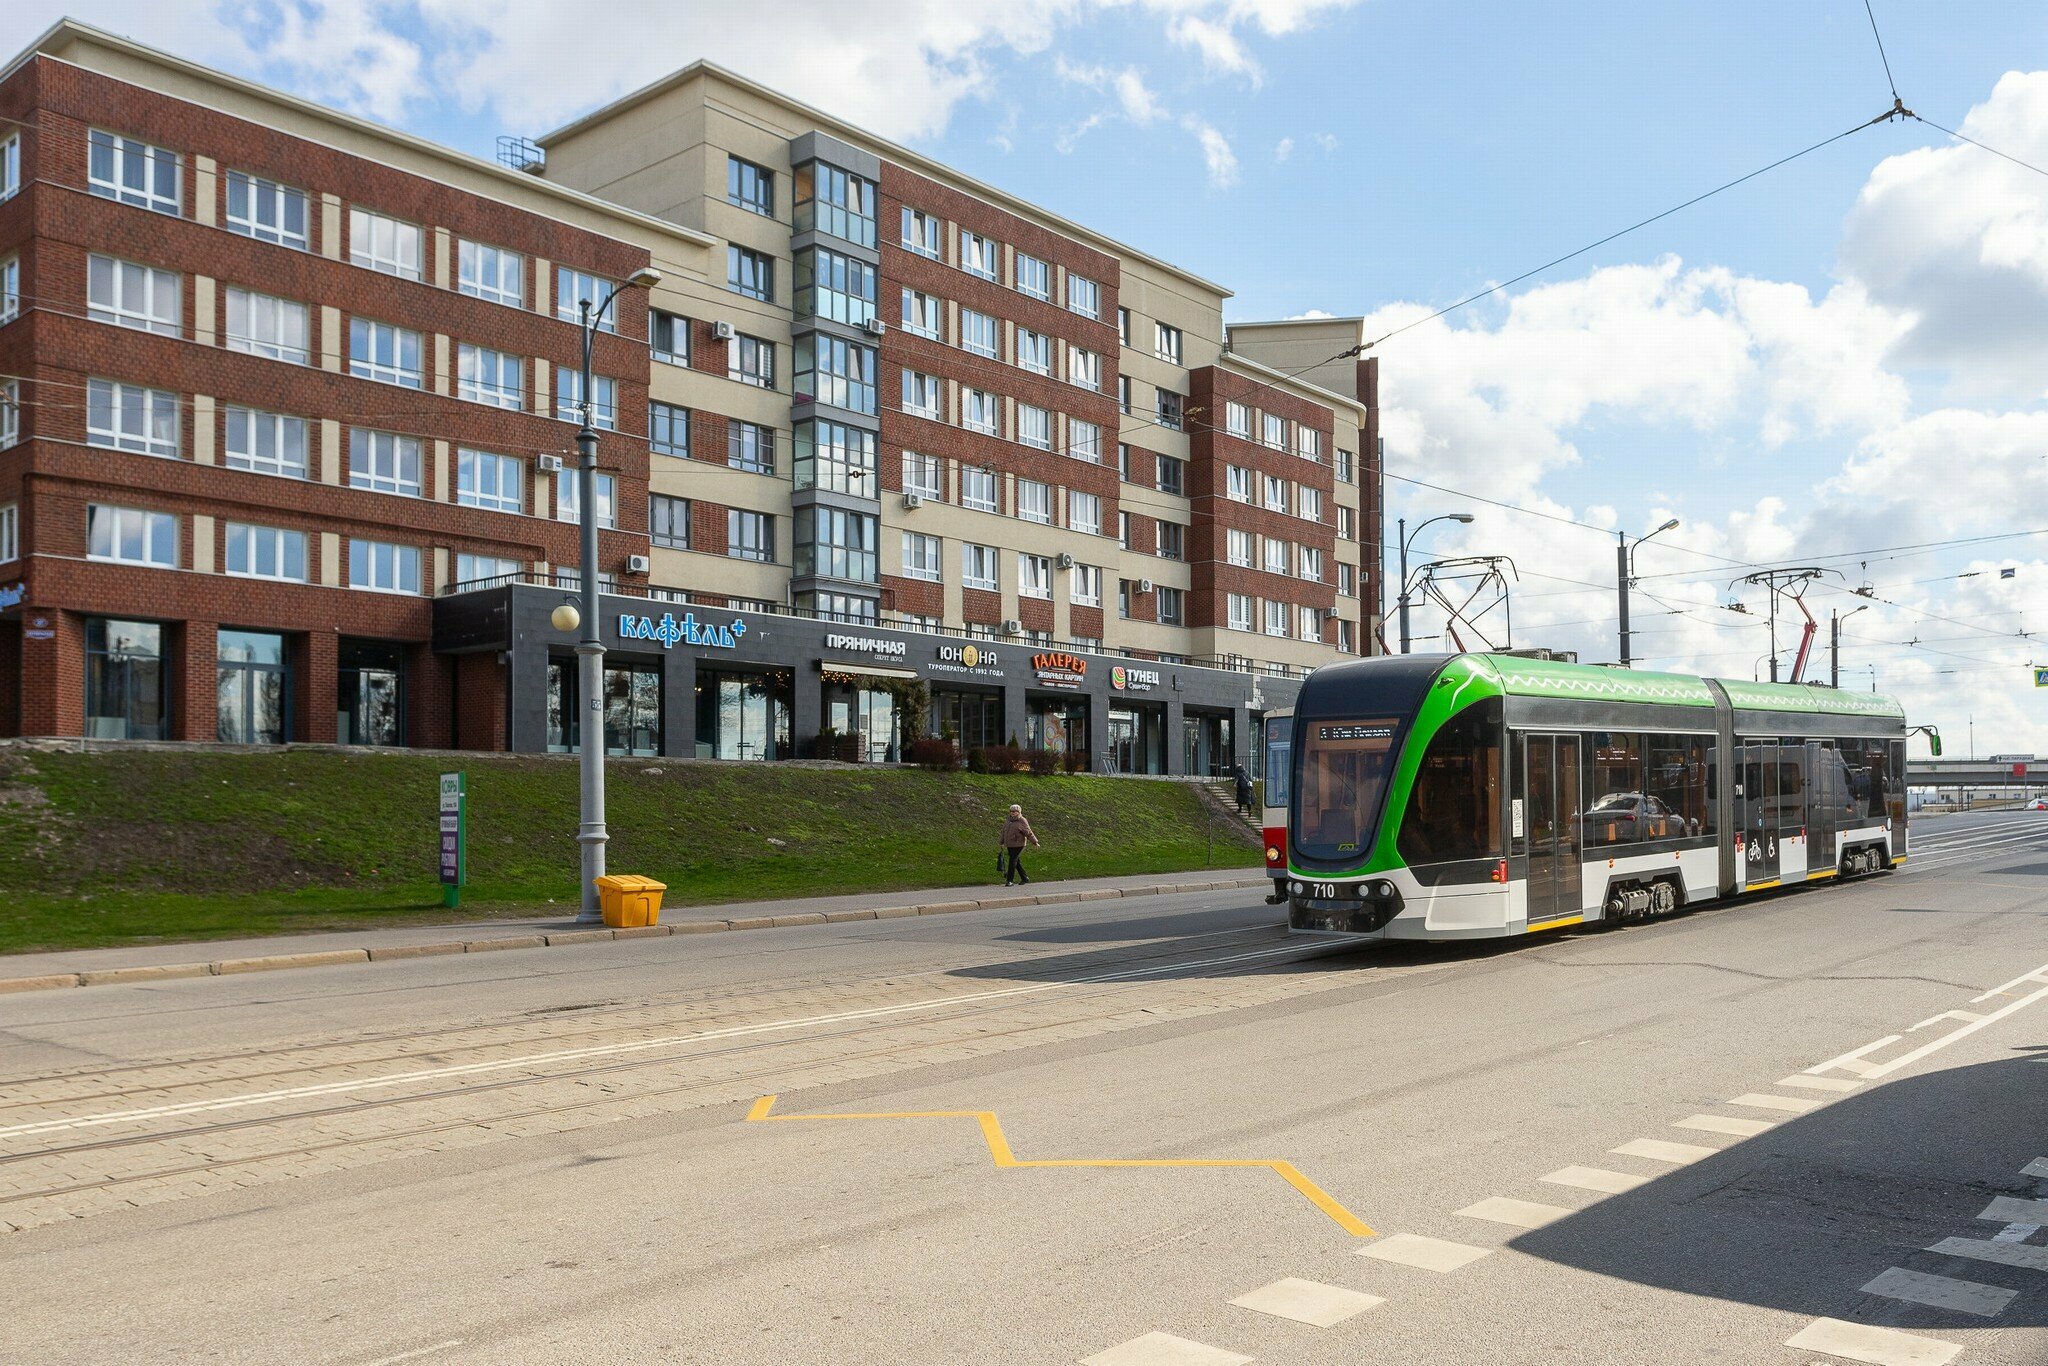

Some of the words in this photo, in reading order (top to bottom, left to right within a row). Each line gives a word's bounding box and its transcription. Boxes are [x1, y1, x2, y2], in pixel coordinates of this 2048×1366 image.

[826, 633, 906, 656] ПРЯНИЧНАЯ
[928, 663, 968, 673] ТУРОПЕРАТОР
[989, 669, 1004, 677] ГОДА
[1032, 652, 1087, 675] ГАЛЕРЕЯ
[1126, 668, 1160, 686] ТУНЕЦ
[1313, 883, 1335, 898] 710
